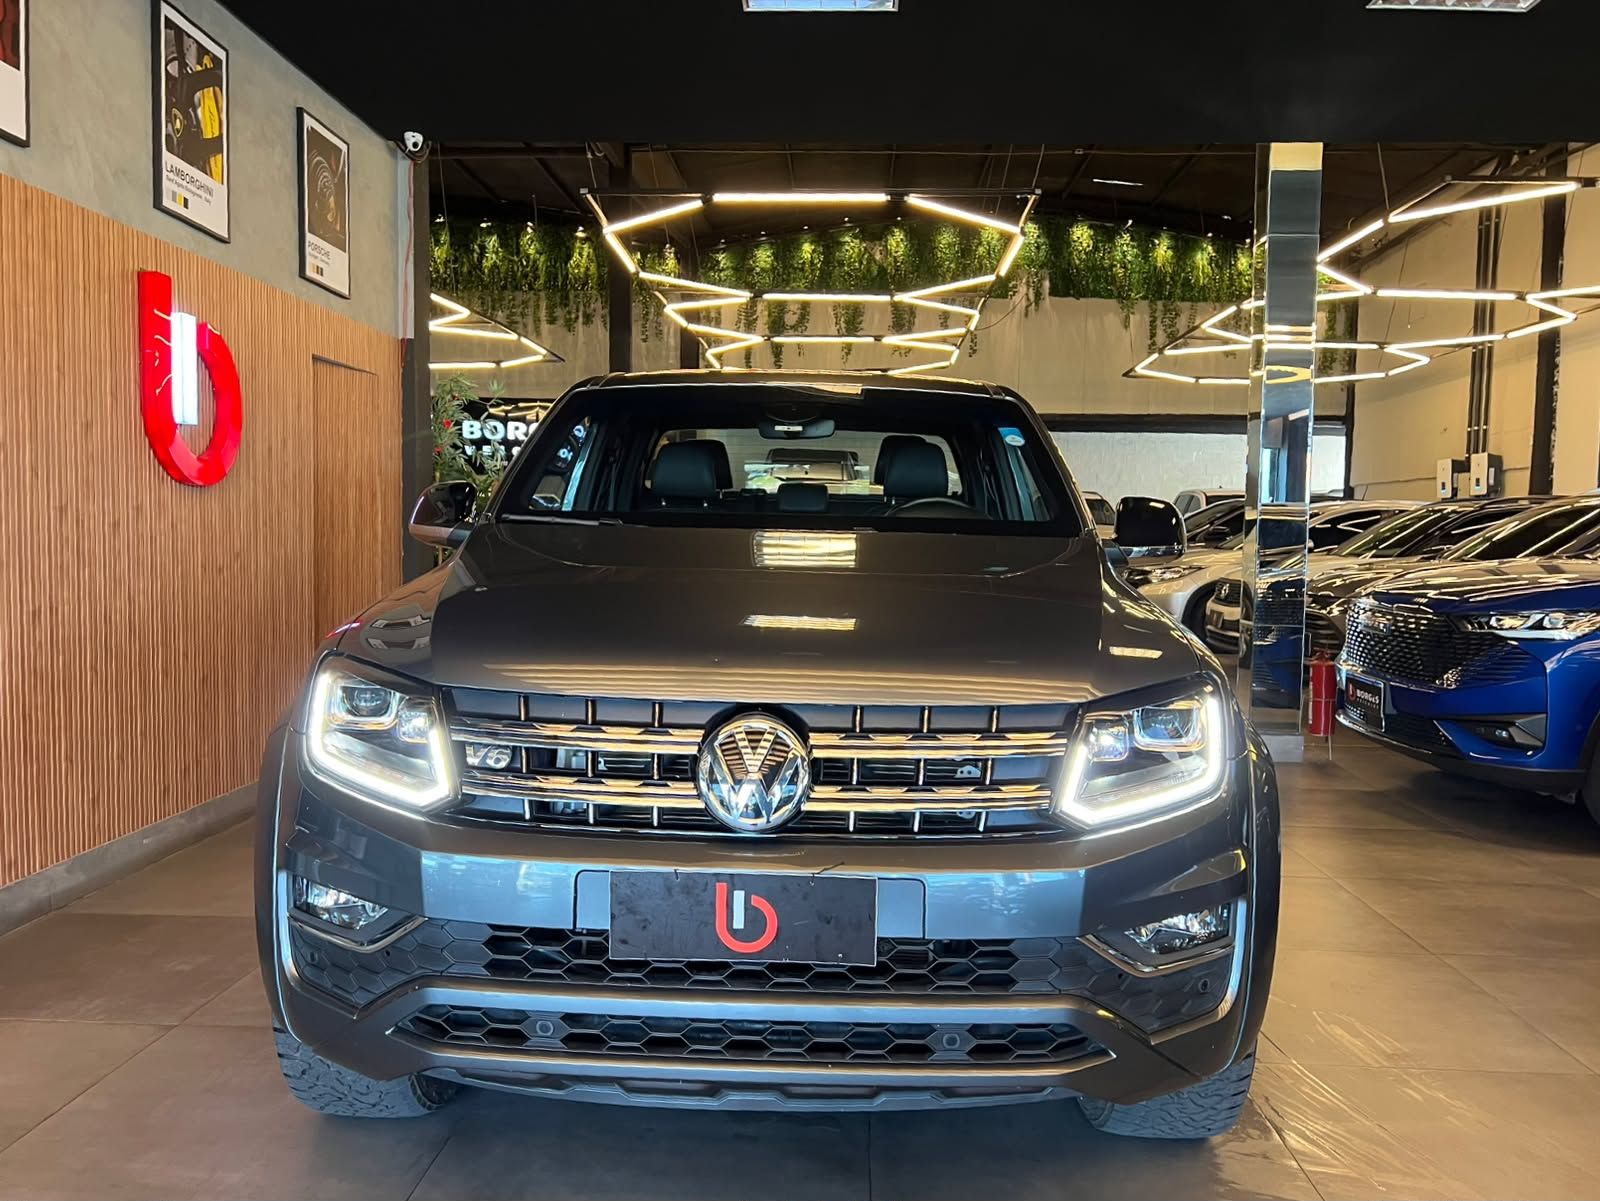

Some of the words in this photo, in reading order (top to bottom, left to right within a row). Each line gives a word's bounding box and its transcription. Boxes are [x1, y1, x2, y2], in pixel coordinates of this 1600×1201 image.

[165, 161, 214, 199] LAMBORGHINI
[307, 240, 331, 260] PORSCHE
[465, 744, 512, 770] V6
